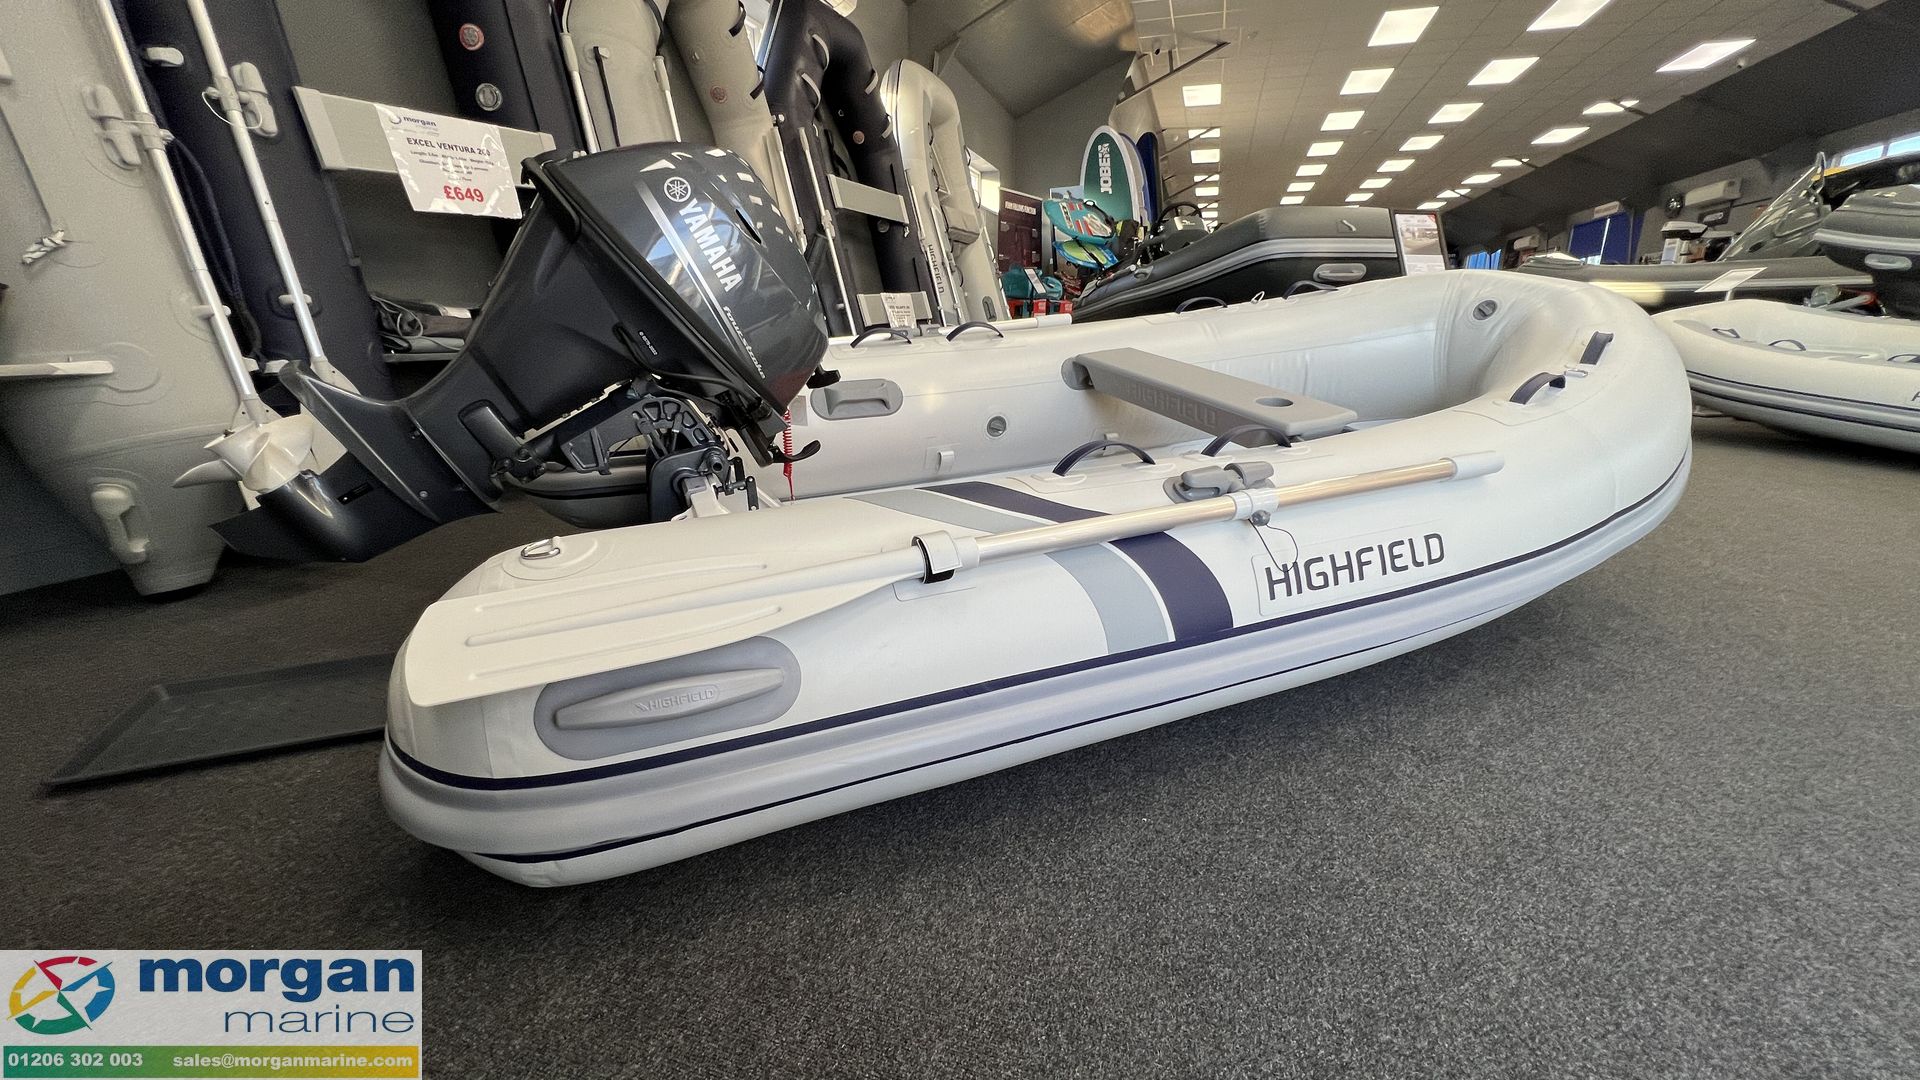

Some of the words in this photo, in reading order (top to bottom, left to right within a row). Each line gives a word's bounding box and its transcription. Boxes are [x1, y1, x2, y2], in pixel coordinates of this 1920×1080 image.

[403, 116, 437, 127] morgan
[406, 137, 436, 148] EXCEL
[437, 142, 476, 154] VENTURA
[1098, 157, 1113, 195] JOBE
[443, 185, 484, 203] £649
[678, 198, 743, 292] YAMAHA
[928, 244, 945, 294] HIGHFIELD
[1265, 533, 1445, 601] HIGHFIELD
[648, 689, 715, 709] HIGHFIELD
